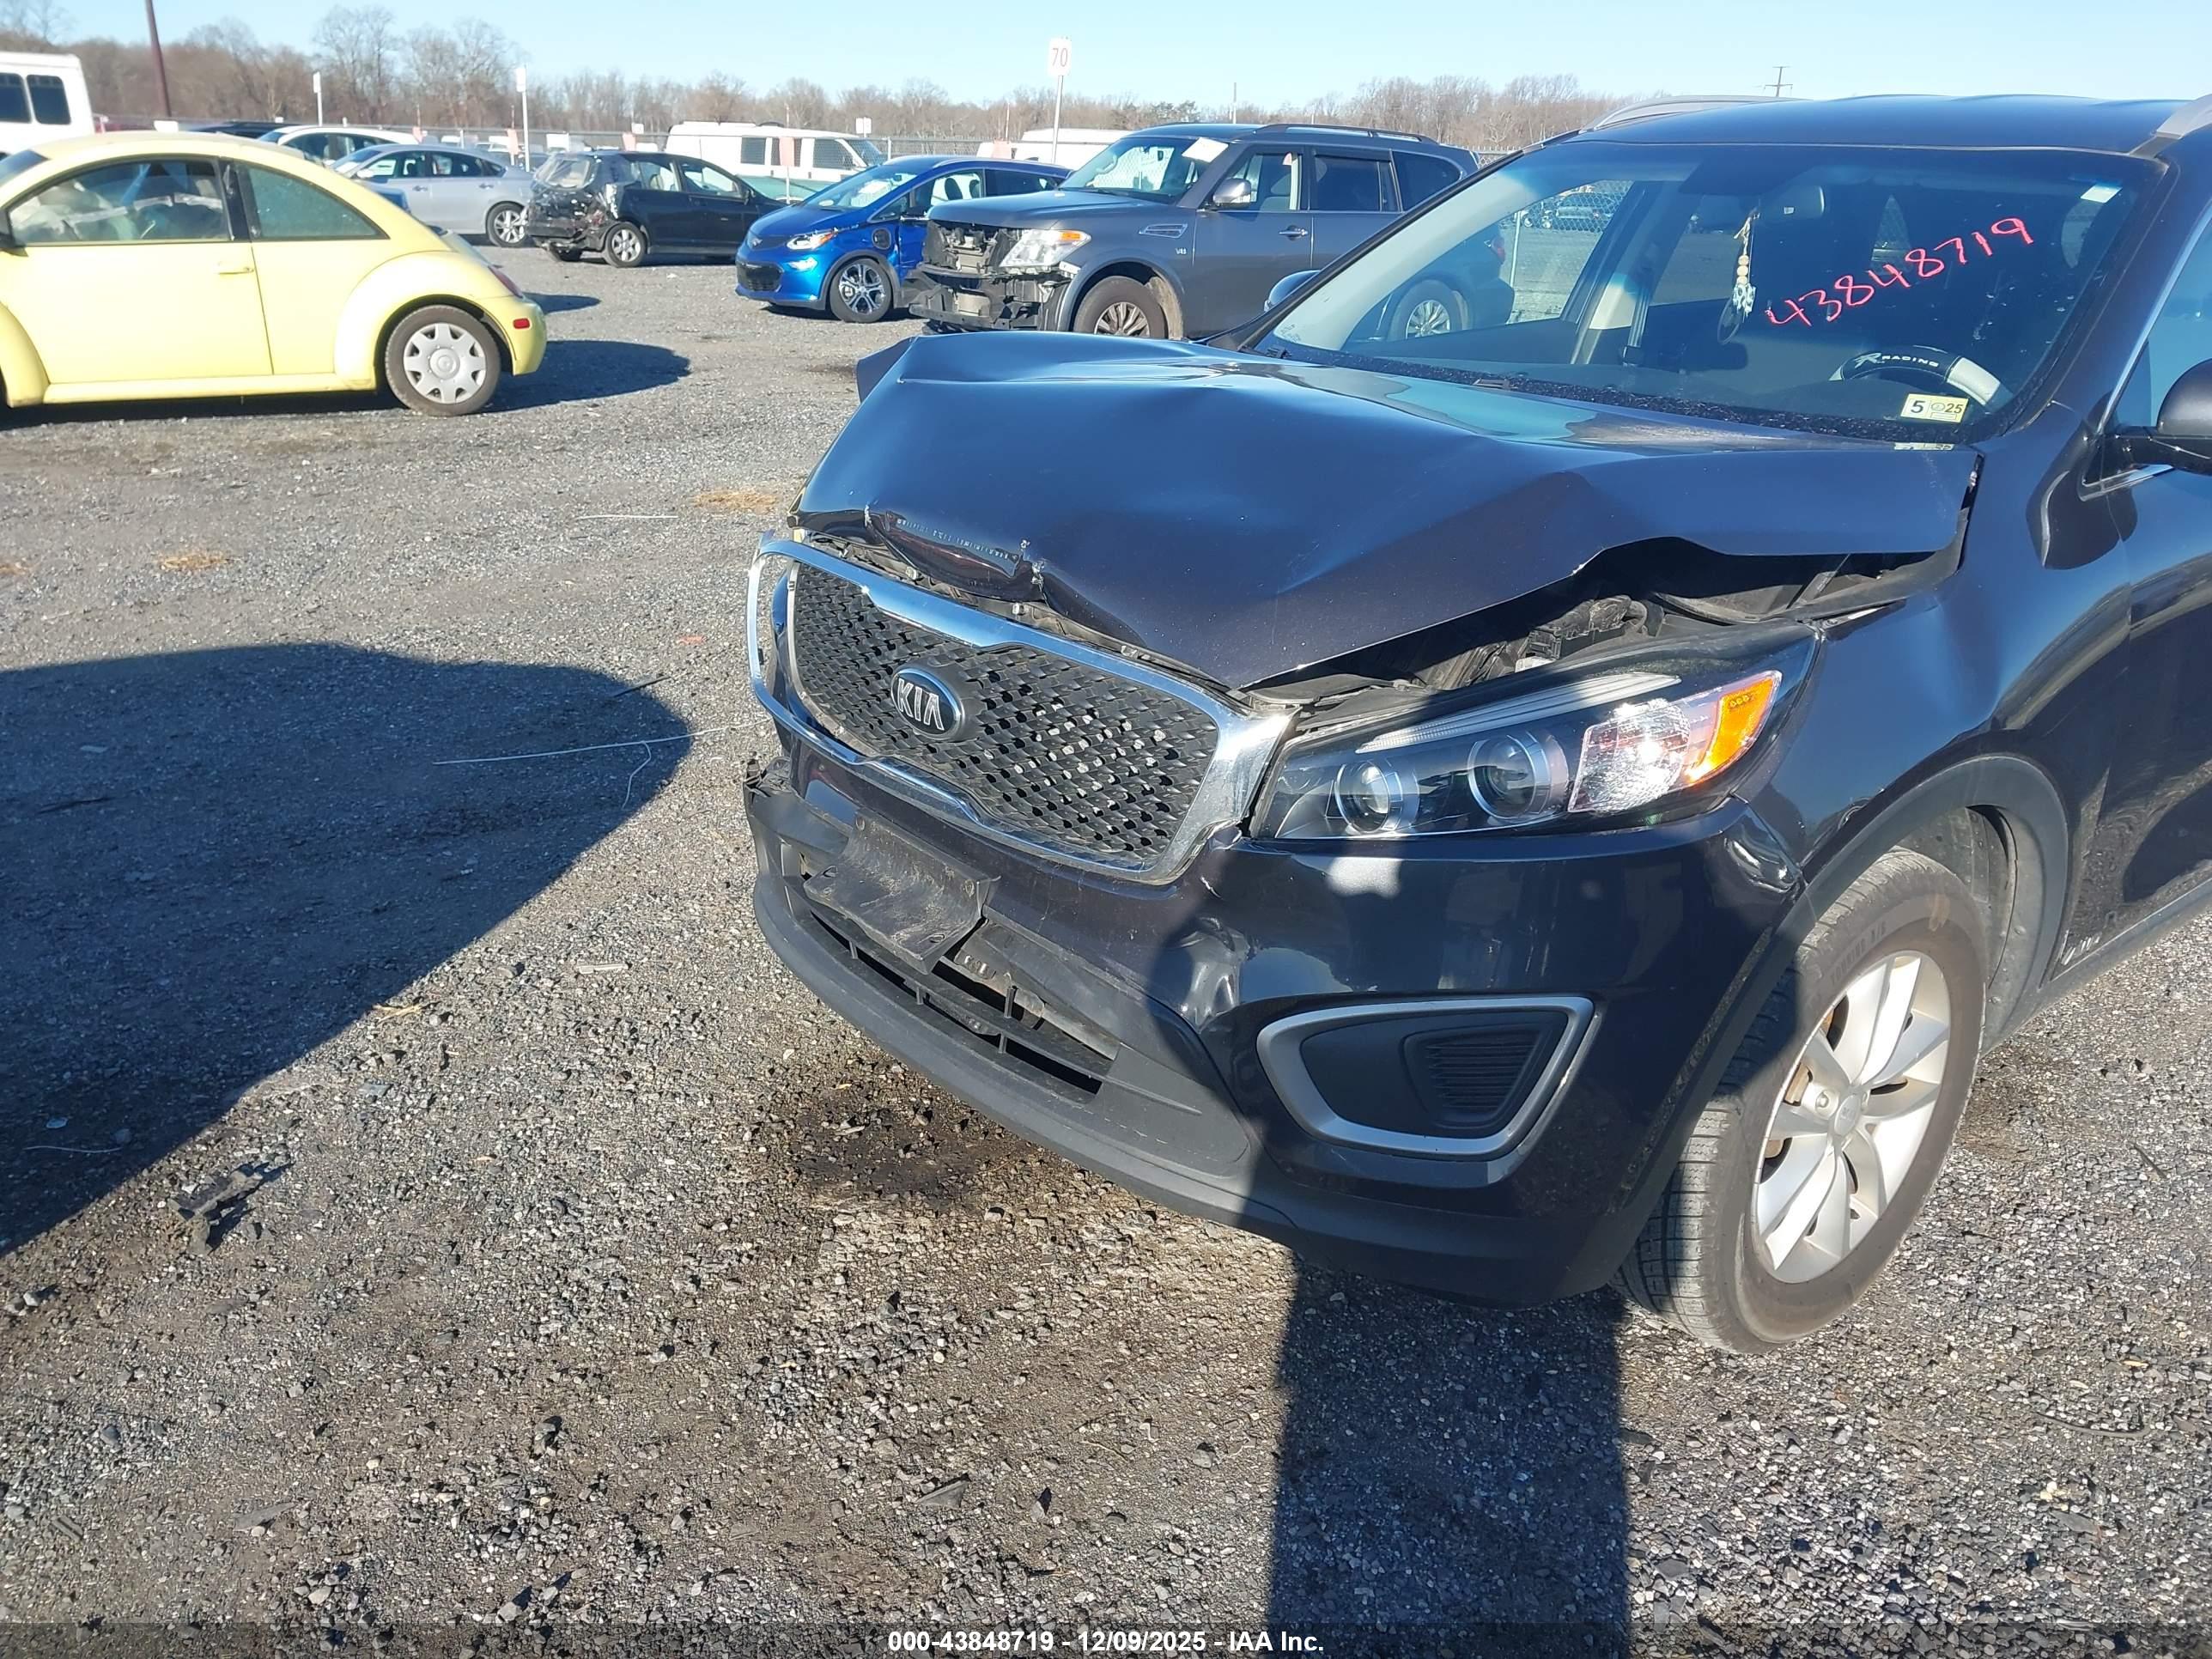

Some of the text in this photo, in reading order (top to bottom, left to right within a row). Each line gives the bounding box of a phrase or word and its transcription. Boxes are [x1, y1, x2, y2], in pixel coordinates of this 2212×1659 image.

[1053, 48, 1068, 67] 70
[1764, 216, 2034, 326] 43848719
[1911, 400, 1964, 414] 5 25
[897, 678, 945, 731] KIA
